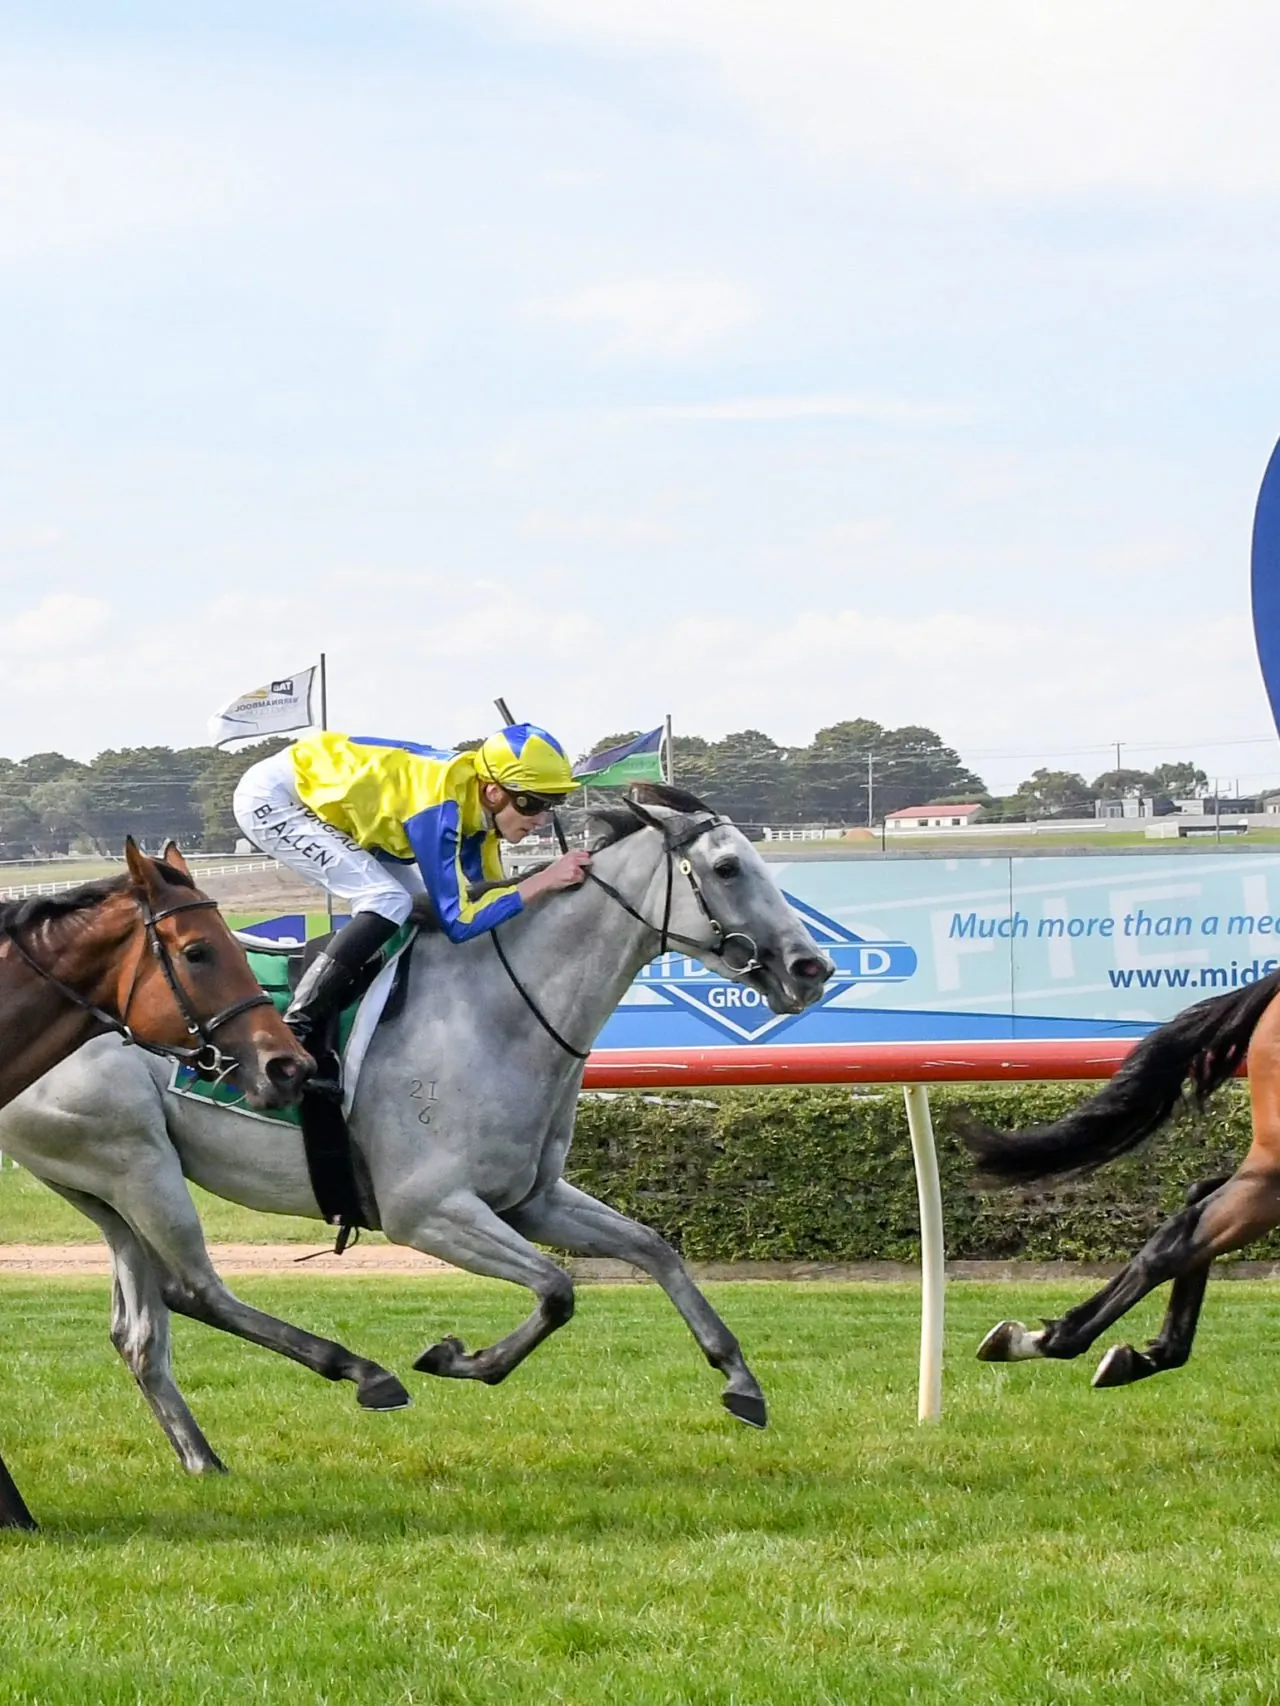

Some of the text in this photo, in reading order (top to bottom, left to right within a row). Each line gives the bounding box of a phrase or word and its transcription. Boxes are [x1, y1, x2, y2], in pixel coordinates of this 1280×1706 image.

[270, 821, 334, 867] ALLEN
[949, 912, 1029, 938] Much
[1037, 916, 1115, 937] more
[1123, 910, 1192, 936] than
[1201, 915, 1219, 935] a
[707, 987, 769, 1008] GRO
[418, 1105, 431, 1125] 6
